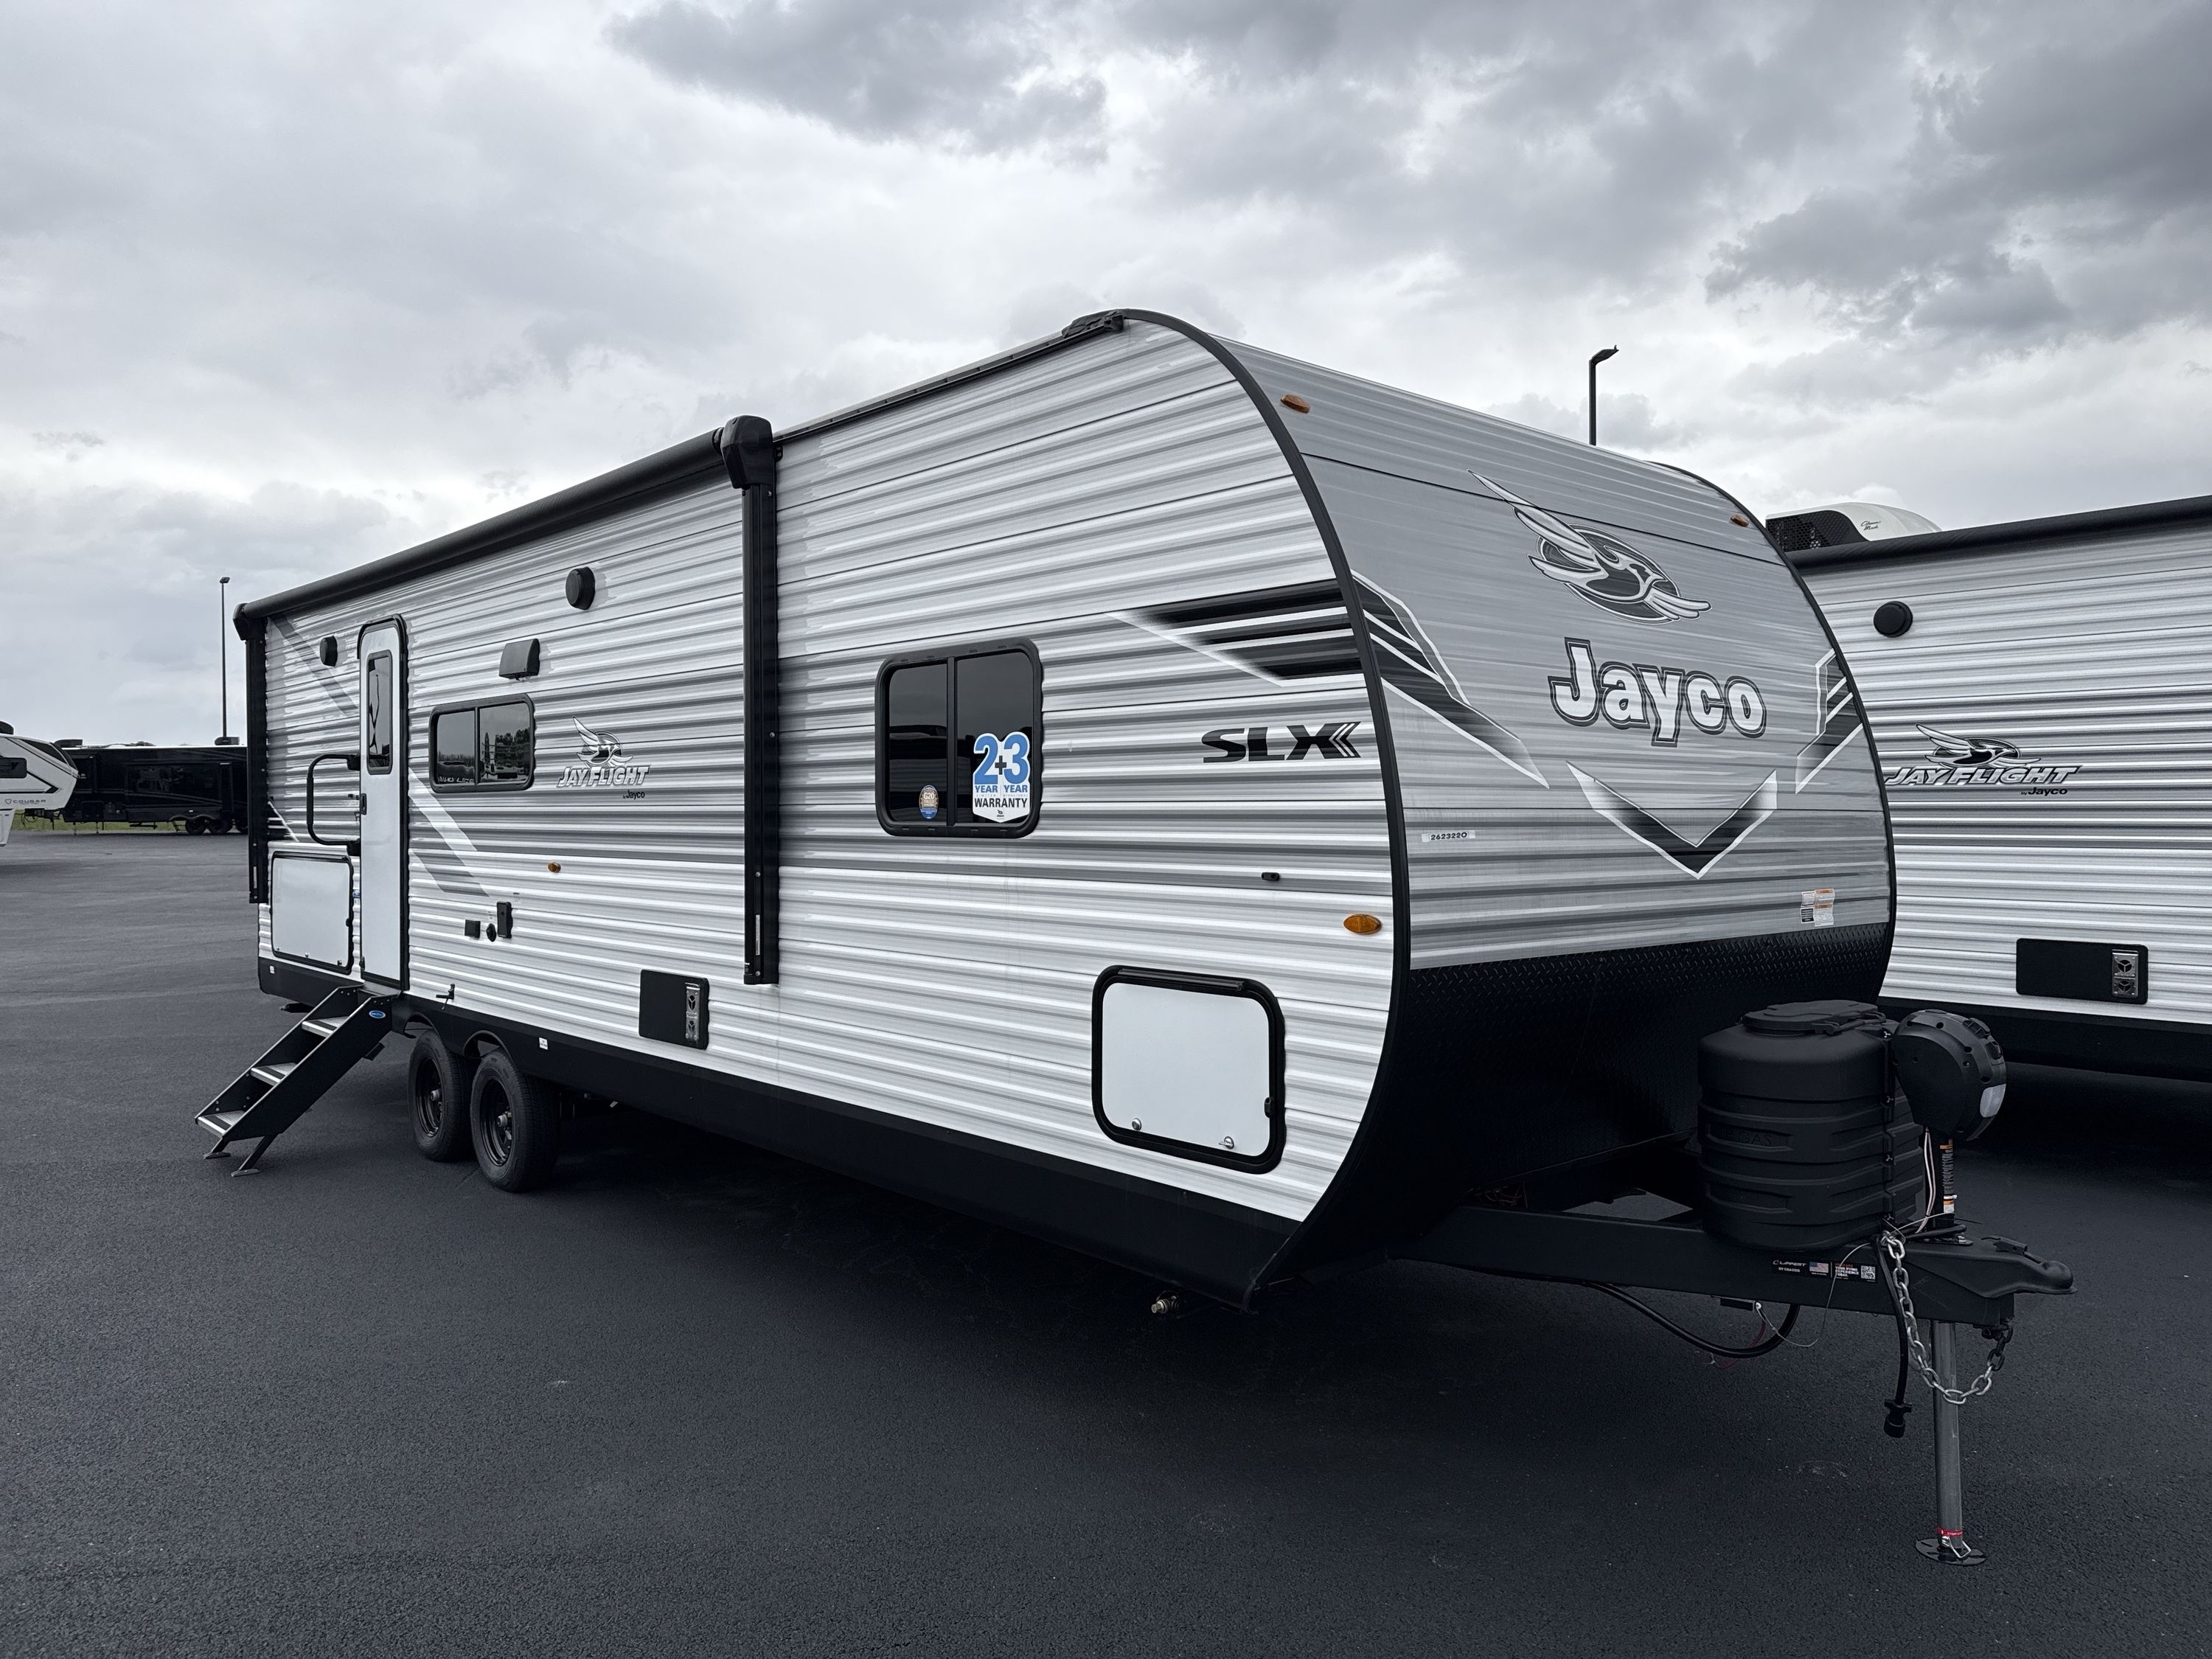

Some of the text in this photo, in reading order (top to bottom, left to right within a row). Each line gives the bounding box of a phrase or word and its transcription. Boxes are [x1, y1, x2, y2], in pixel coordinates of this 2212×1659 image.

[1548, 637, 1767, 748] Jayco
[1201, 721, 1362, 763] SLX
[557, 765, 650, 788] JAY FLIGHT
[1884, 765, 2084, 785] JAY FLIGHT
[975, 785, 1028, 793] YEAR YEAR
[2028, 787, 2068, 796] Jayco
[626, 790, 645, 800] Jayco
[923, 792, 935, 800] G20
[974, 798, 1028, 808] WARRANTY
[1430, 832, 1467, 841] 2623220
